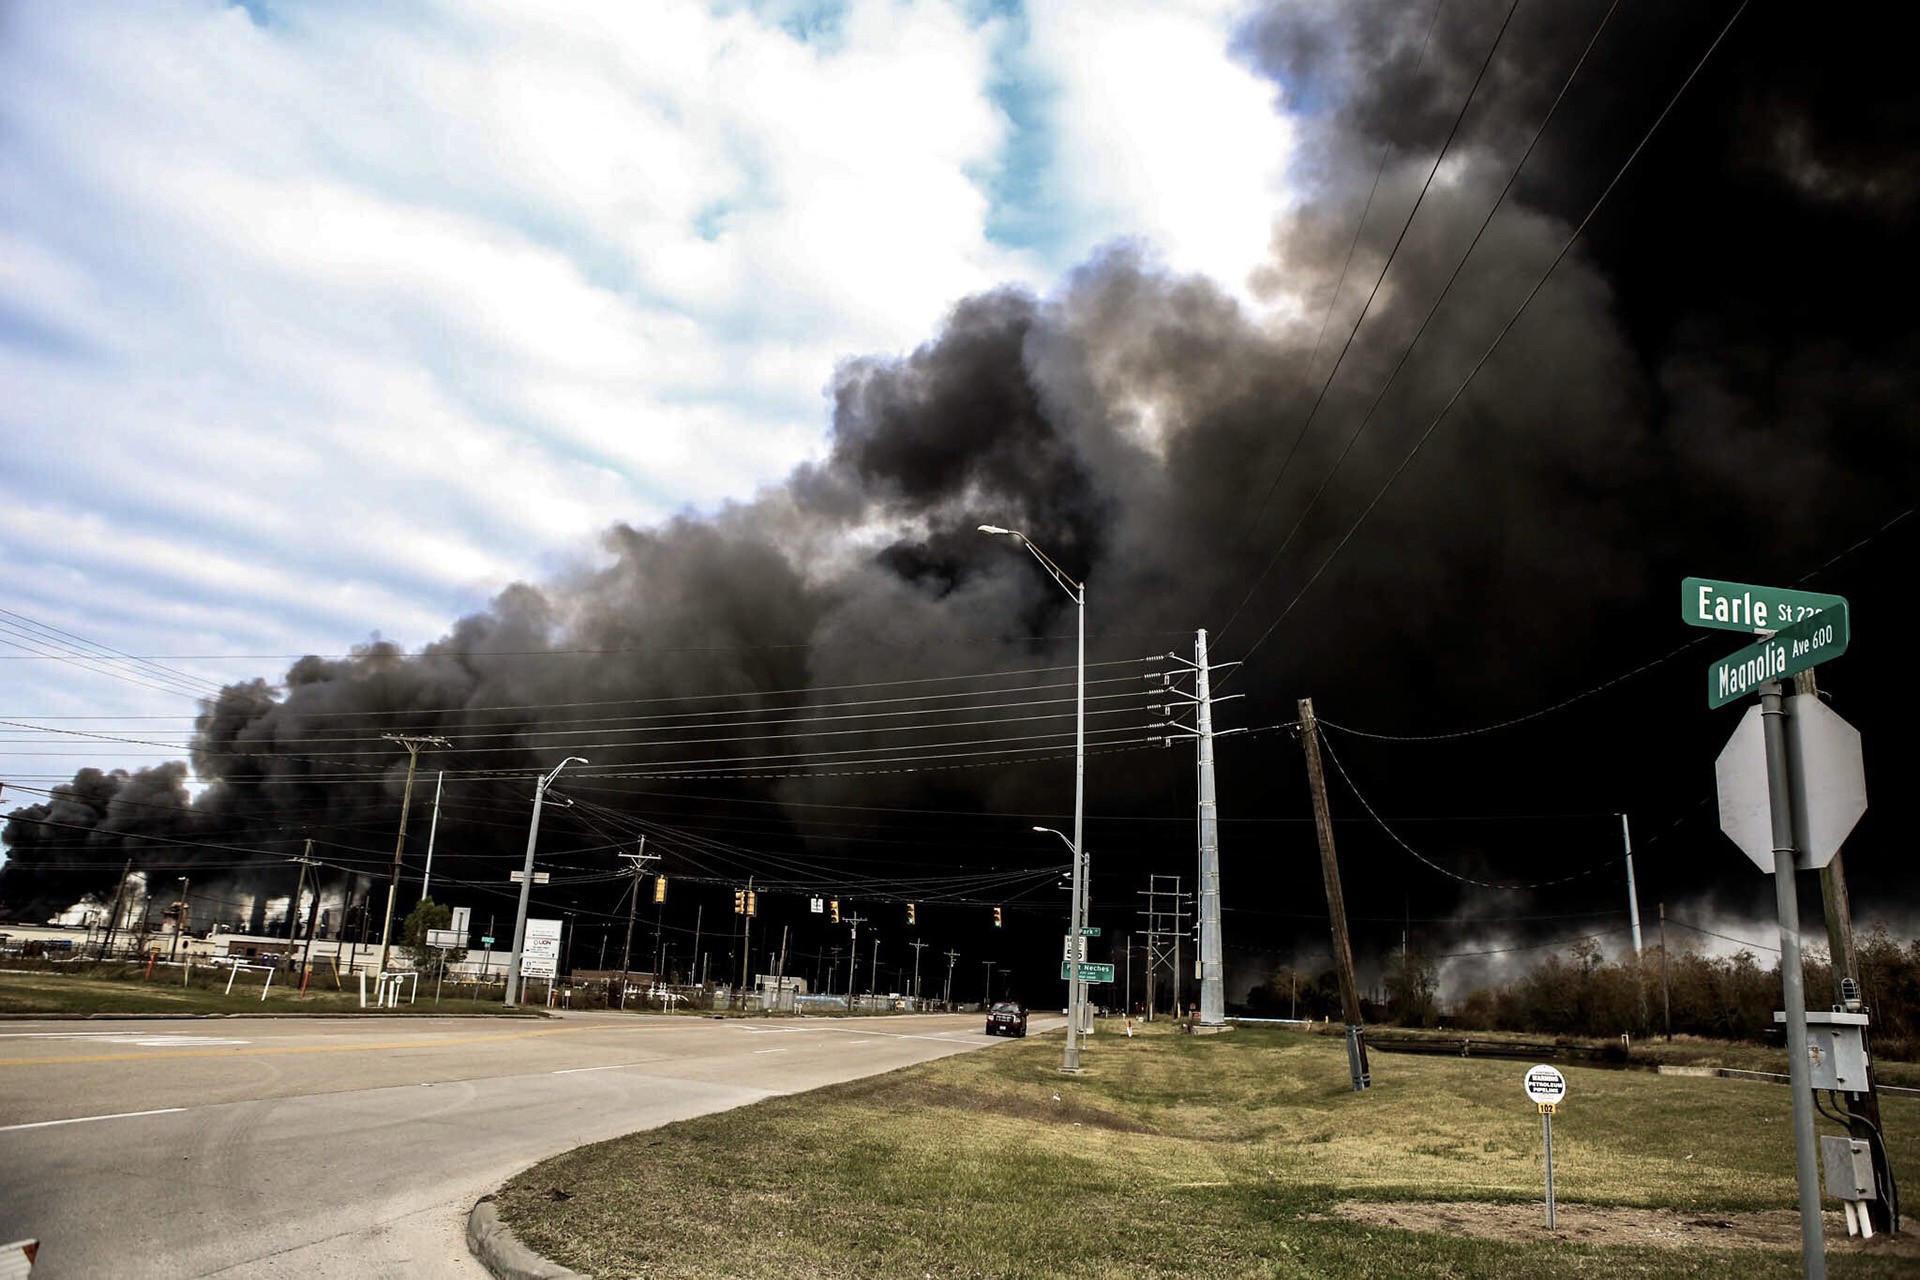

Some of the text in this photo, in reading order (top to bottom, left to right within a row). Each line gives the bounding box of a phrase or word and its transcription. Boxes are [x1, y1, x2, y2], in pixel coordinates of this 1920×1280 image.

[1698, 585, 1823, 627] Earle St 22
[1718, 624, 1833, 698] Magnolia Ave 600
